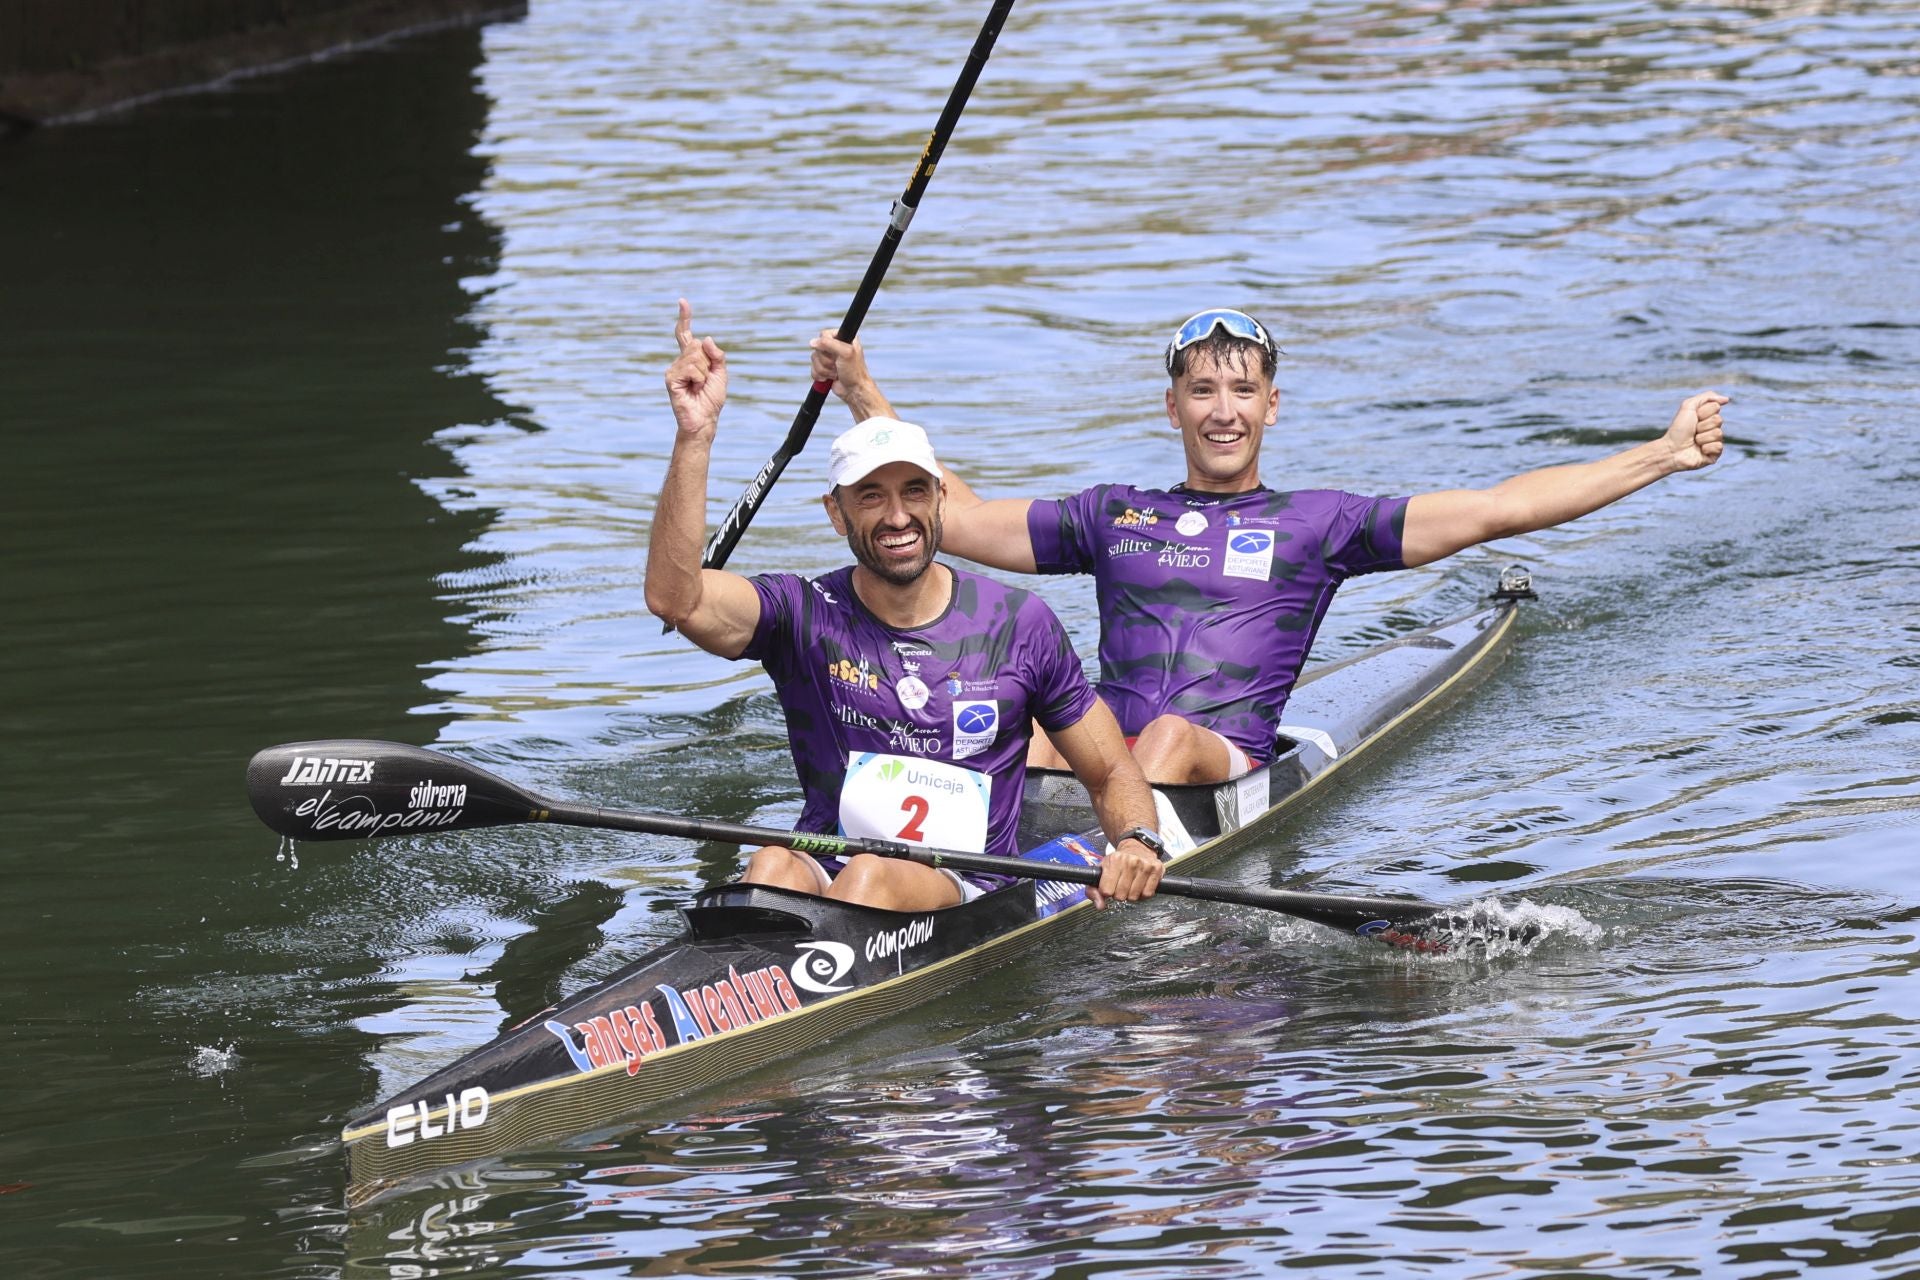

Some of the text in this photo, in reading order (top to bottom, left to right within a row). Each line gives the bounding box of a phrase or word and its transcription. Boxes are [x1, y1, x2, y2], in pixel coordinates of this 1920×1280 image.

[1108, 538, 1152, 558] salitre
[1168, 554, 1210, 568] VIEJO
[1227, 557, 1269, 567] DEPORTE
[890, 720, 904, 734] La
[899, 738, 941, 753] VIEJO
[955, 738, 993, 746] DEPORTE
[281, 757, 375, 783] JANTEX
[907, 769, 964, 795] Unicaja
[295, 789, 332, 817] el
[896, 795, 929, 842] 2
[865, 916, 934, 975] campanu
[544, 963, 801, 1077] Cangas Aventura
[387, 1086, 489, 1148] ELIO
